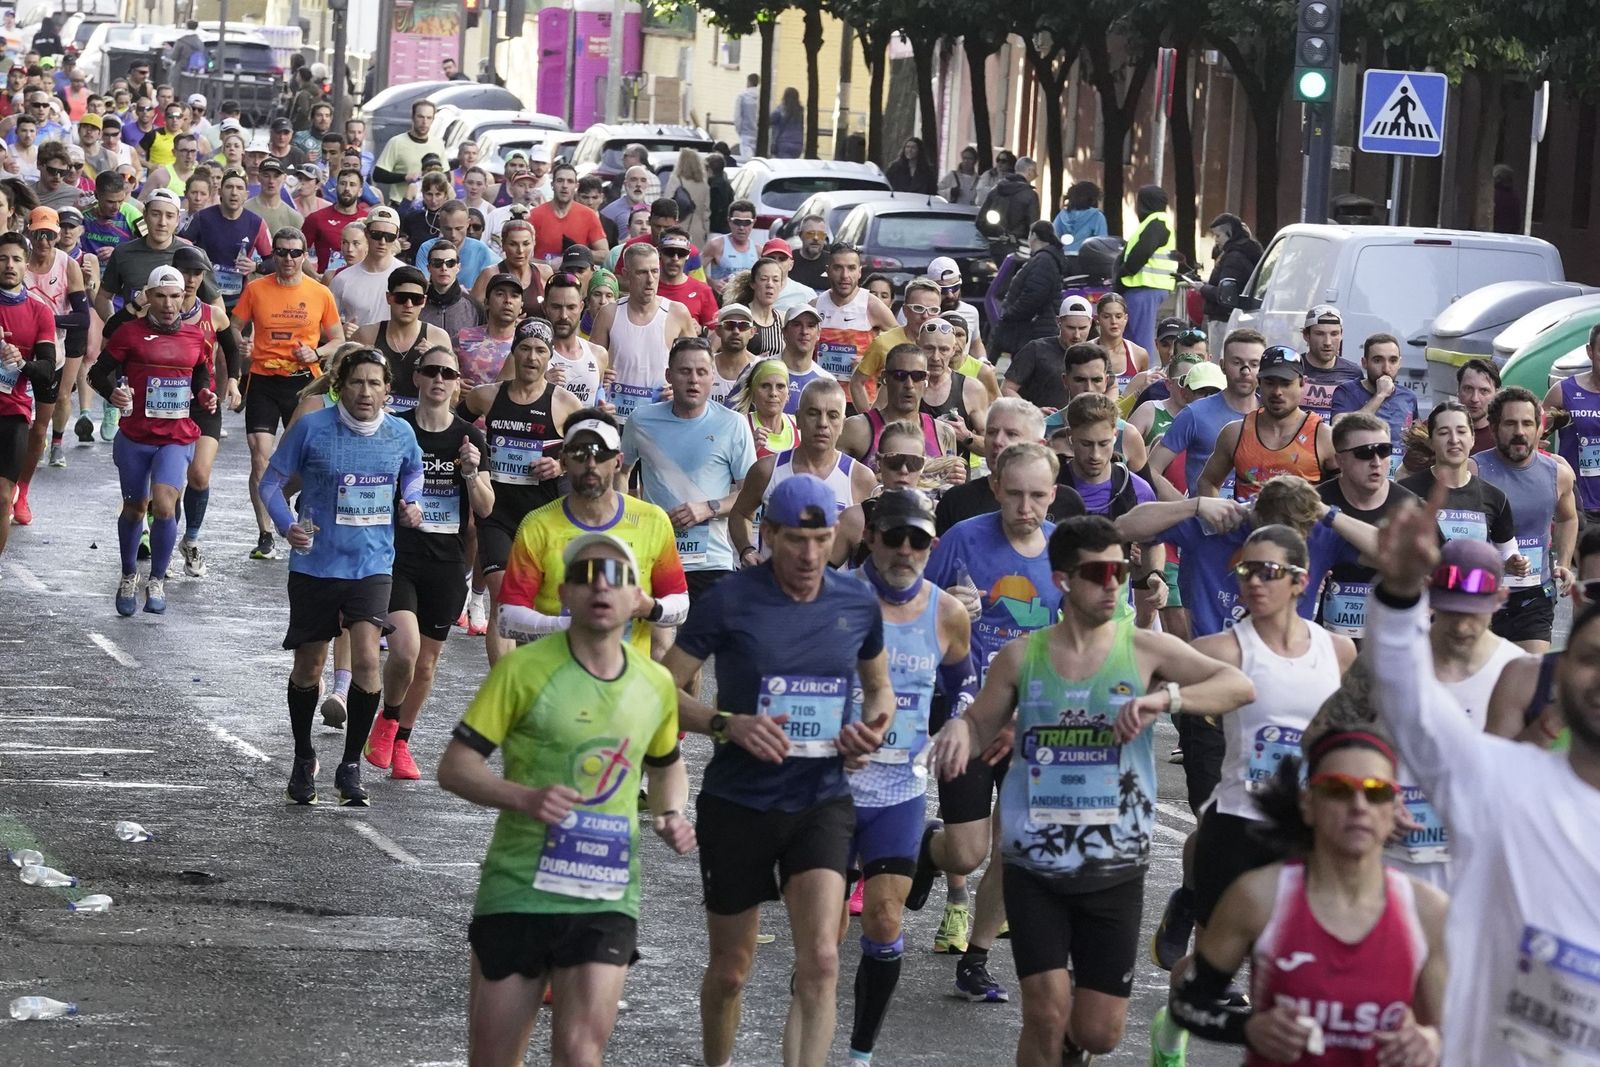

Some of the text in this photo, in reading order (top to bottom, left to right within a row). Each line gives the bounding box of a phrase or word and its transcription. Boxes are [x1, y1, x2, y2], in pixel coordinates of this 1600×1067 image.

[624, 387, 648, 396] ZURICH
[508, 440, 537, 449] ZURICH
[507, 453, 523, 461] 9056
[359, 475, 388, 484] ZURICH
[337, 506, 360, 514] MARIA
[368, 505, 390, 514] BLANCA
[1450, 512, 1480, 521] ZURICH
[1344, 602, 1364, 610] 7357
[979, 622, 992, 634] DE
[891, 647, 935, 672] legal
[791, 681, 839, 694] ZURICH
[791, 705, 816, 717] 7105
[1059, 750, 1107, 762] ZURICH
[1076, 795, 1116, 807] FREYRE
[582, 816, 628, 833] ZURICH
